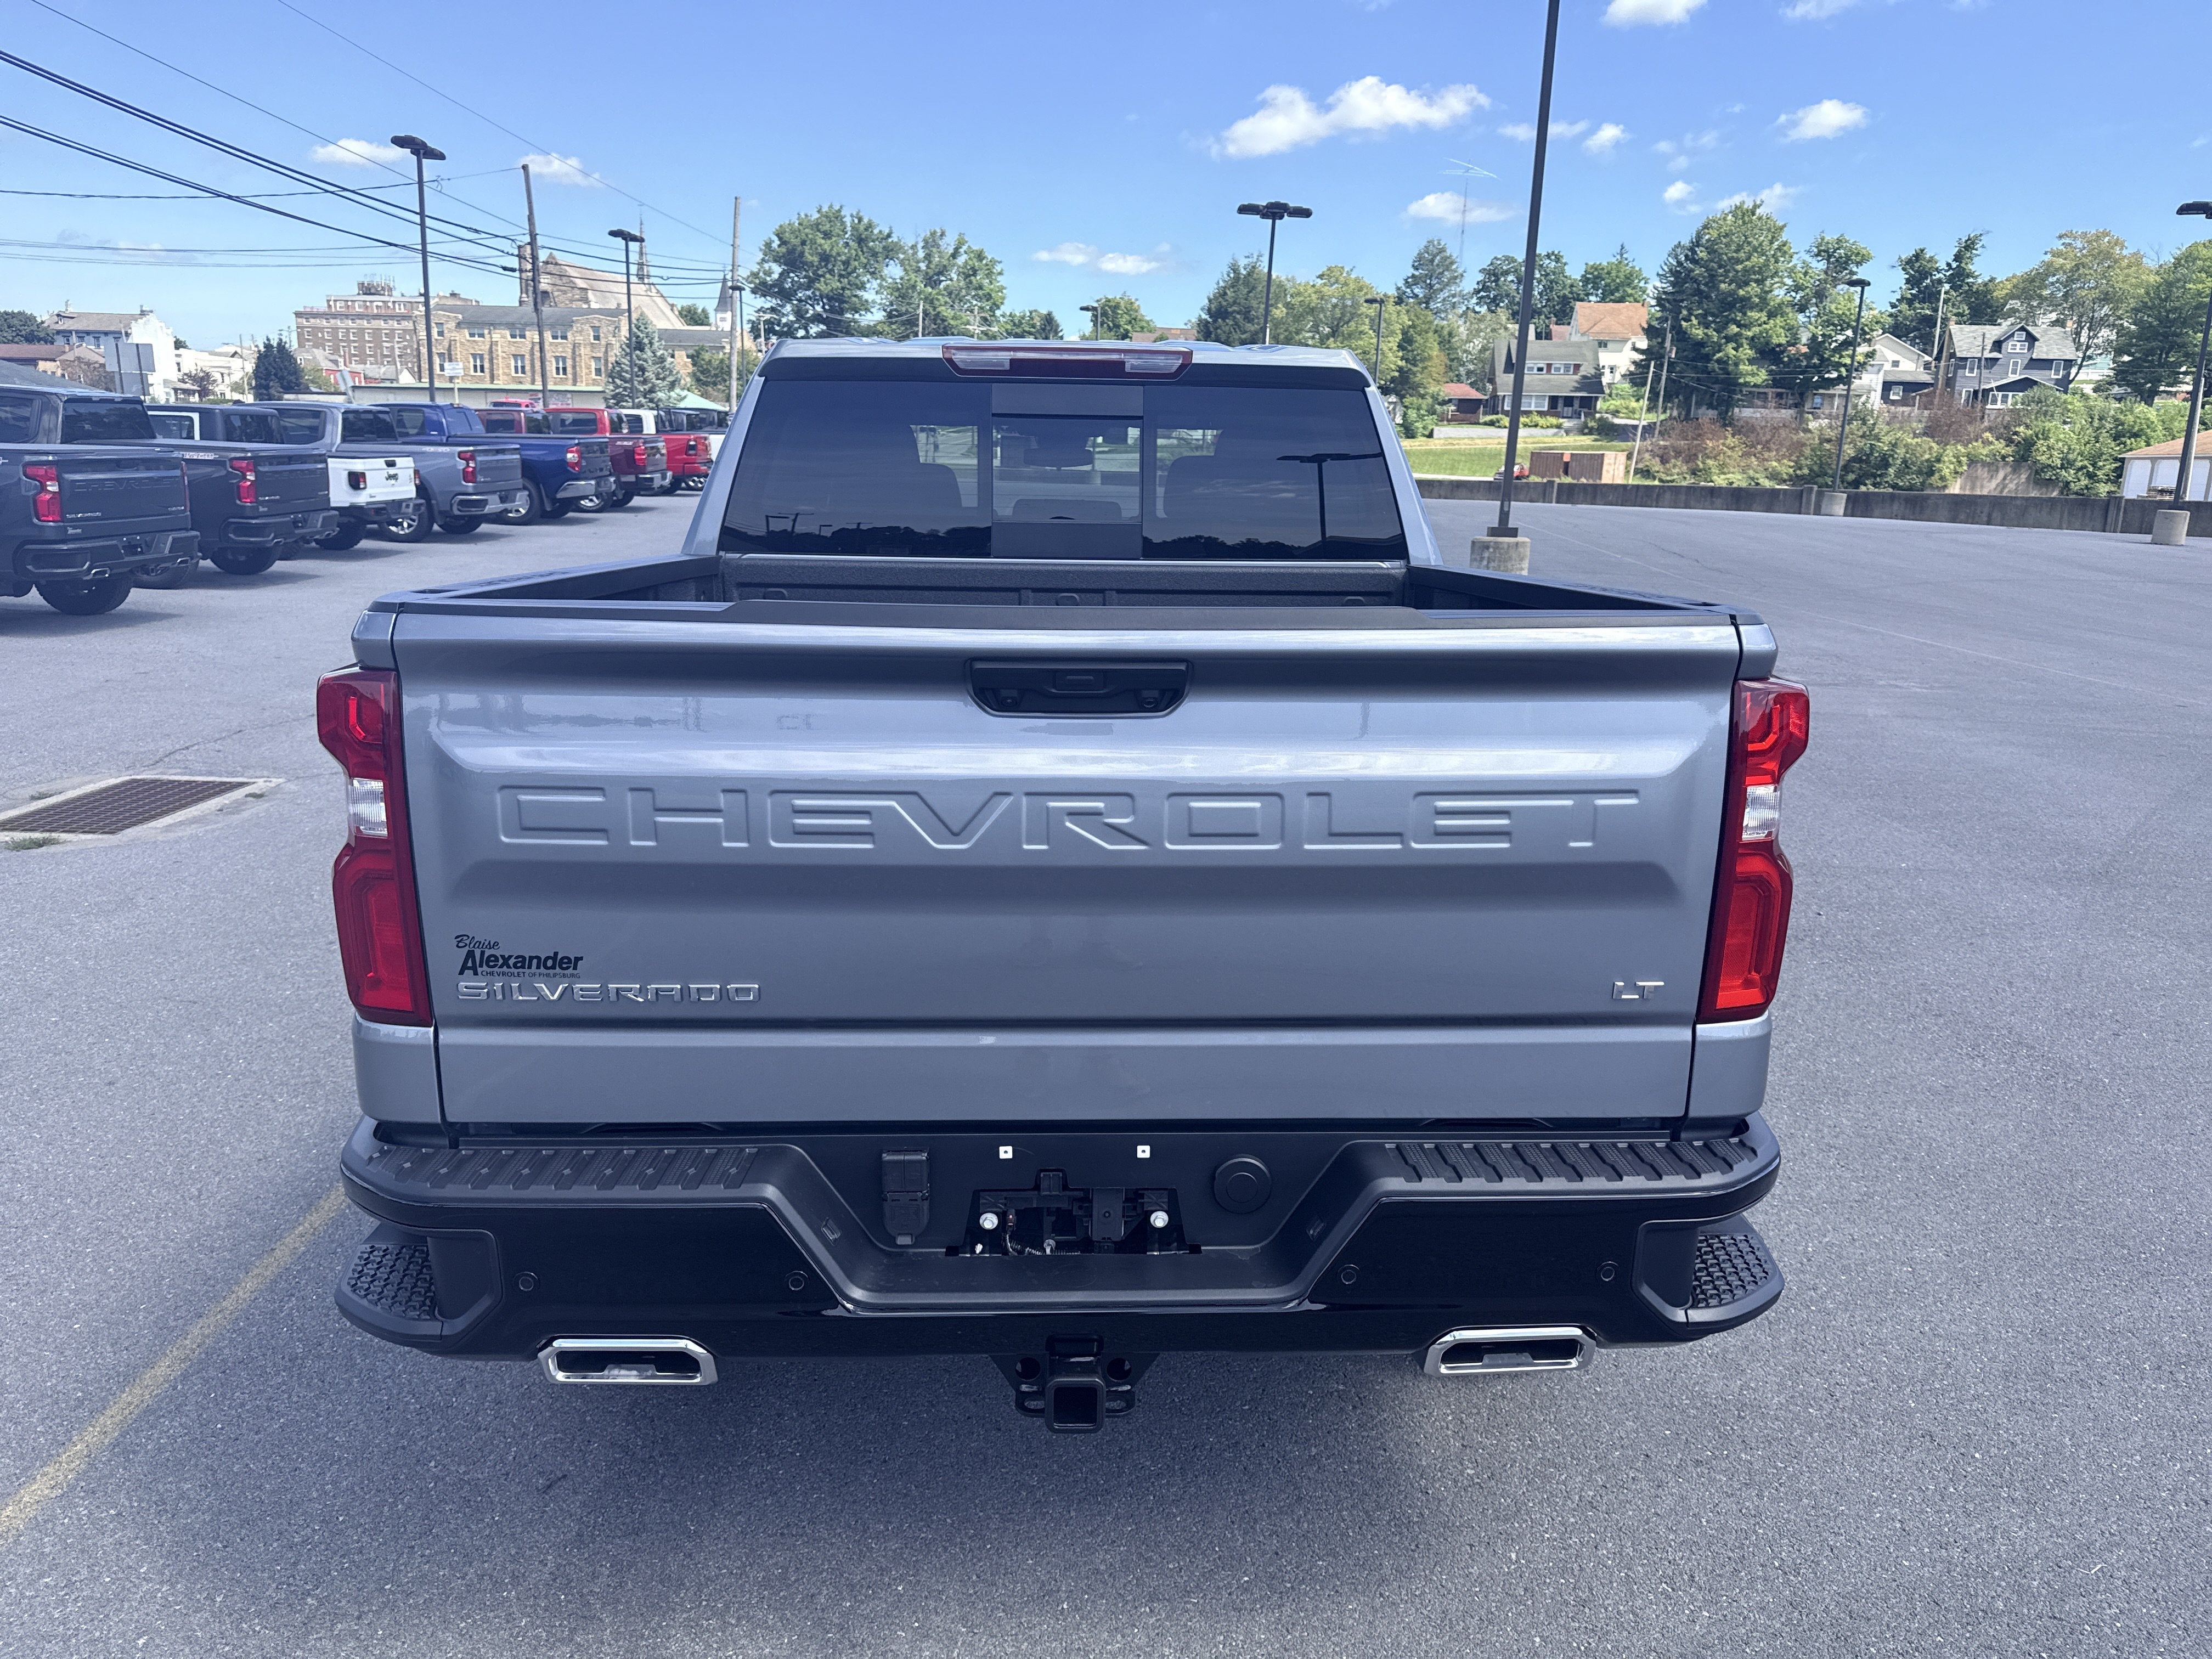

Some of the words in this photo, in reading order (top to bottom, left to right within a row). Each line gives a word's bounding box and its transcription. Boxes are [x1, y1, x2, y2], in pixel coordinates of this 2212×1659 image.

[496, 785, 1640, 850] CHEVROLET
[454, 934, 501, 950] Blaise
[458, 949, 584, 976] Alexander
[481, 970, 527, 978] CHEVROLET
[458, 982, 760, 1002] SILVERADO
[1612, 981, 1665, 1000] LT
